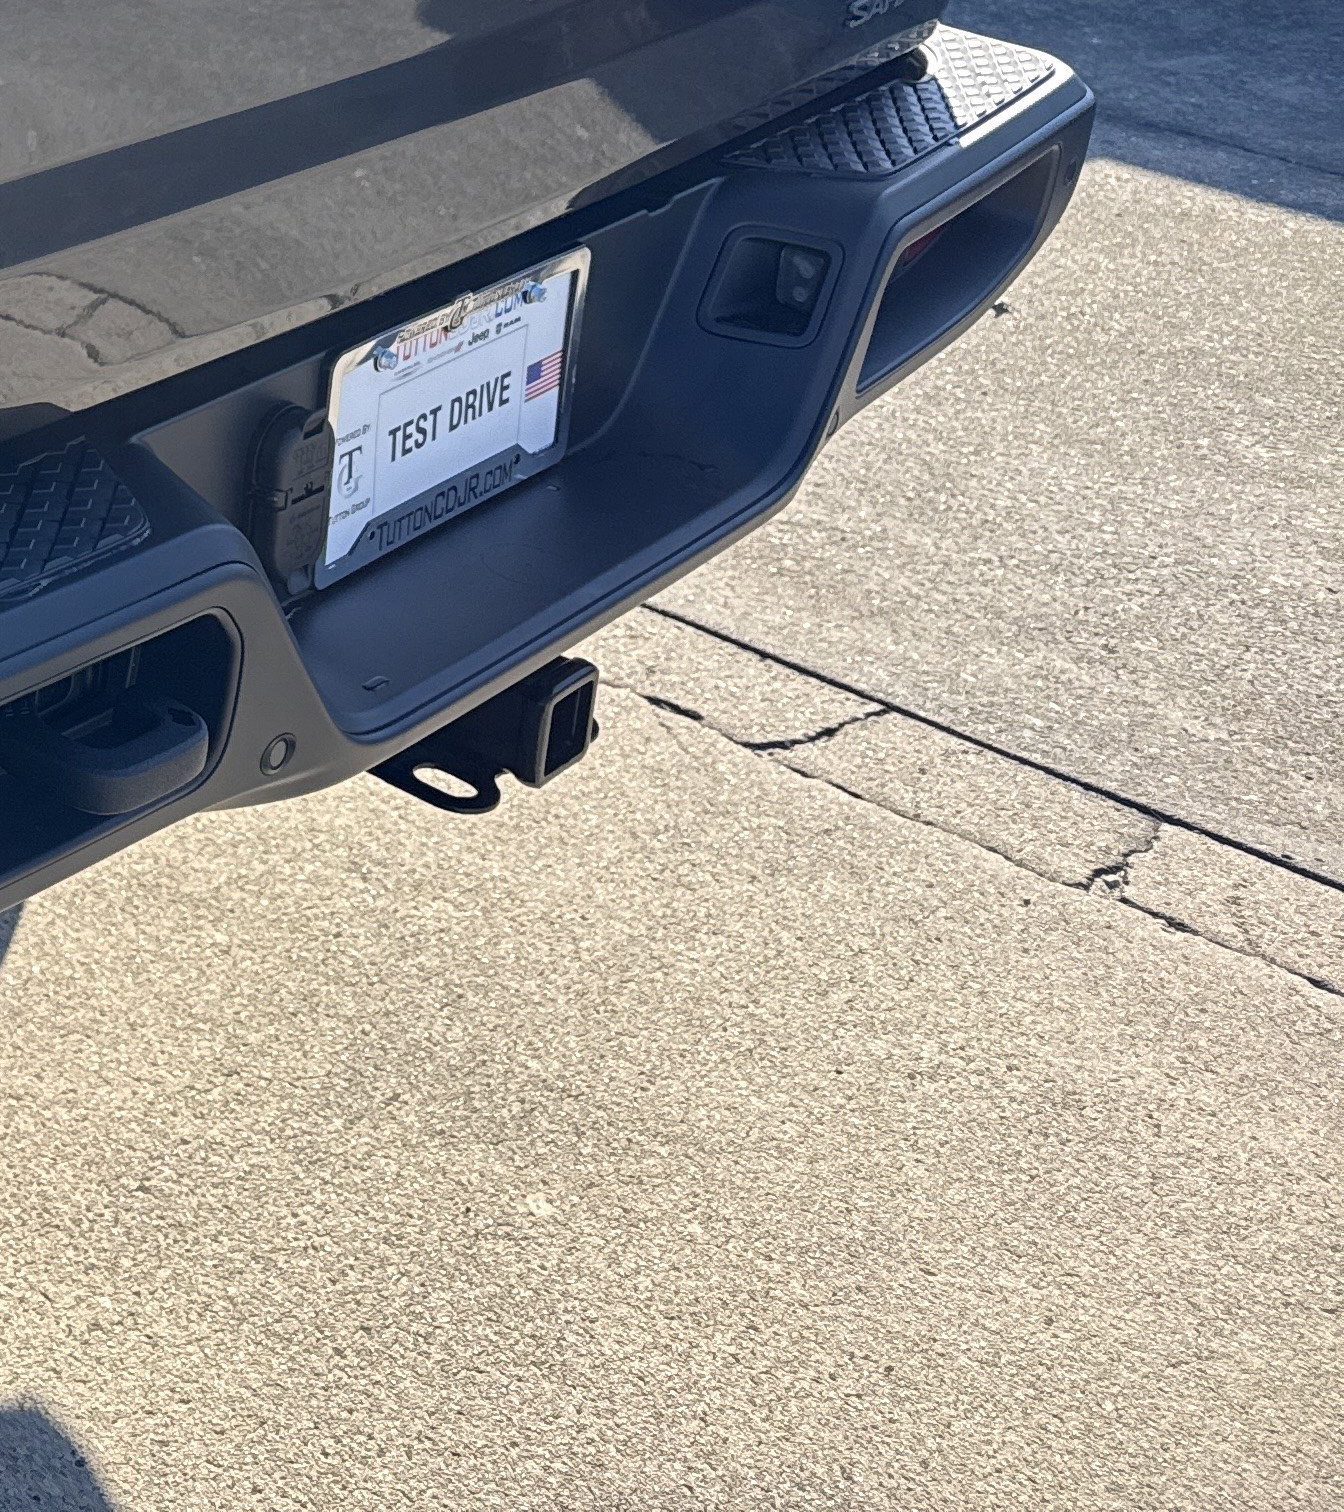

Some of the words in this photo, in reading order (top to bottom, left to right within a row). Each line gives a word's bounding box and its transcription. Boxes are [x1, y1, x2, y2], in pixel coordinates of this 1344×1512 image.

[388, 406, 442, 463] TEST
[449, 371, 512, 433] DRIVE
[376, 459, 514, 552] TUTTONCDJR.COM
